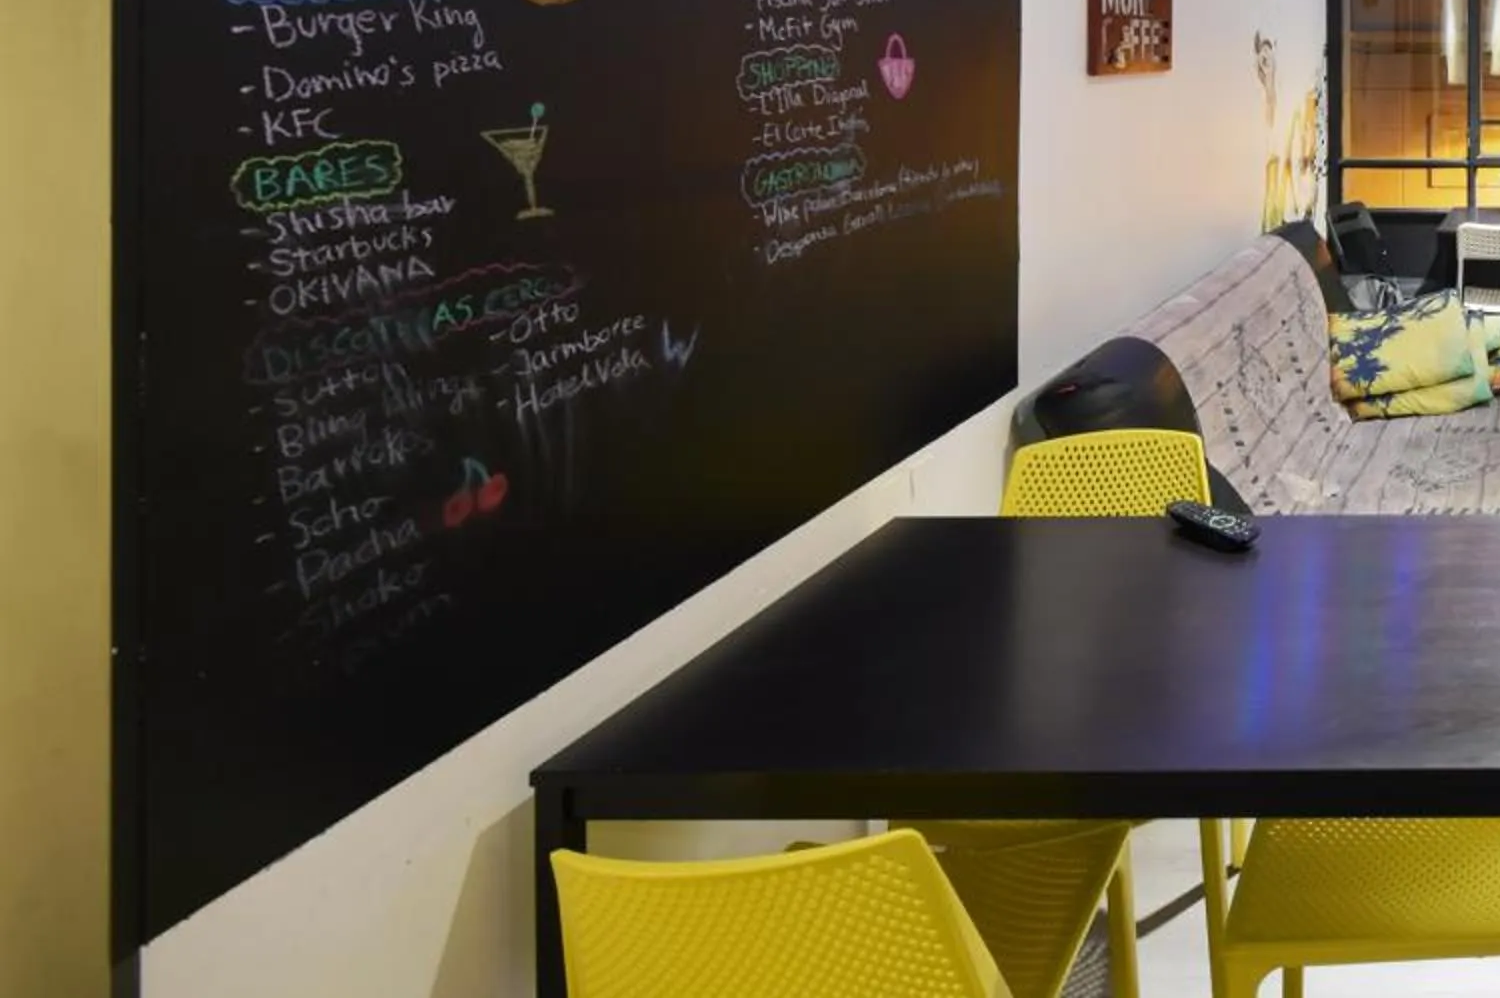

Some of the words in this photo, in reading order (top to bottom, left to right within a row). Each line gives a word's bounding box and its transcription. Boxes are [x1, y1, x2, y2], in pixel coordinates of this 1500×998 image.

[260, 3, 399, 57] Burger
[262, 54, 416, 103] Domino's
[433, 49, 504, 88] pizza
[261, 106, 341, 146] KFC
[254, 154, 390, 202] BARES
[265, 195, 392, 245] Shisha
[268, 225, 434, 277] Starbucks
[508, 302, 580, 344] Otto
